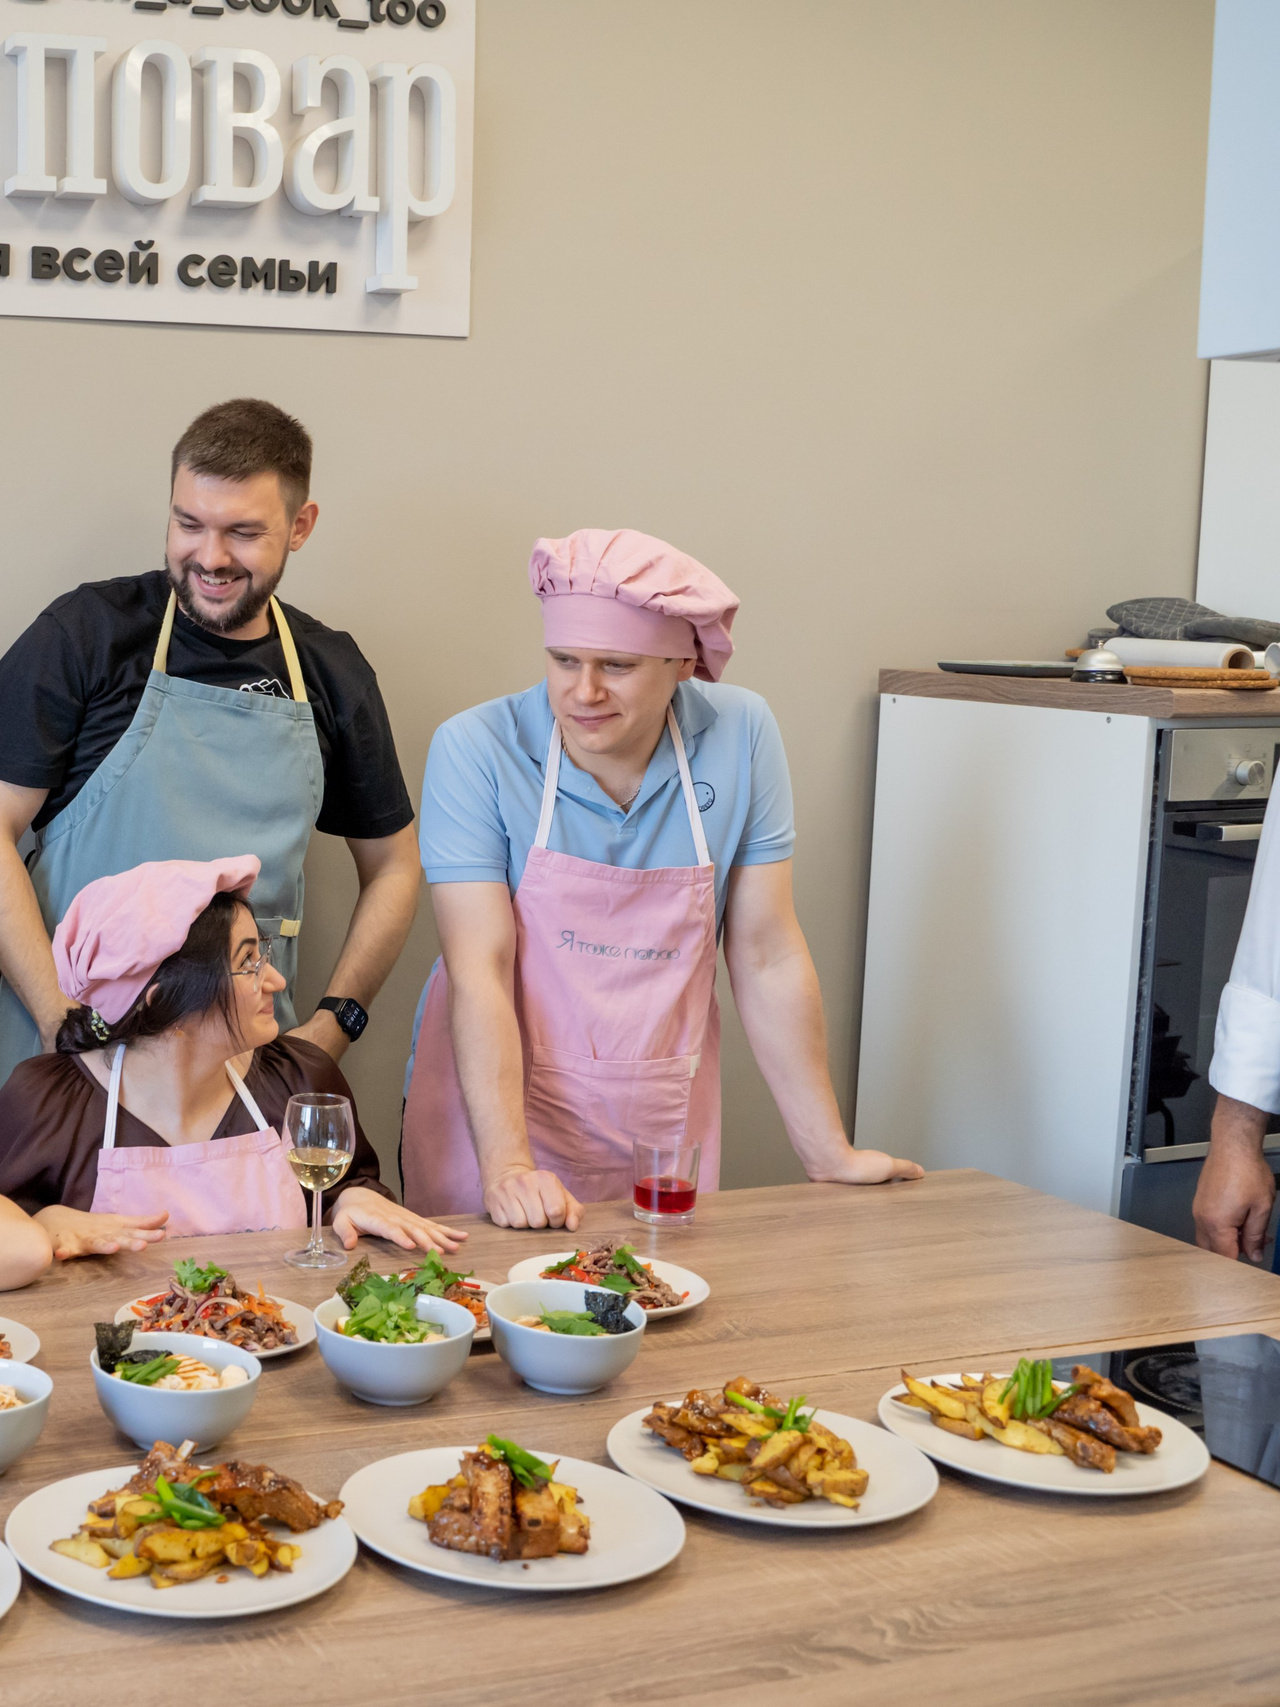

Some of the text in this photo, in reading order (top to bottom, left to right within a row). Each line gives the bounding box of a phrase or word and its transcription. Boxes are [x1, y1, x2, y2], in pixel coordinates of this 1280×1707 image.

[3, 32, 457, 295] повар
[31, 239, 159, 285] всей
[177, 252, 337, 294] семьи
[556, 929, 575, 951] Я
